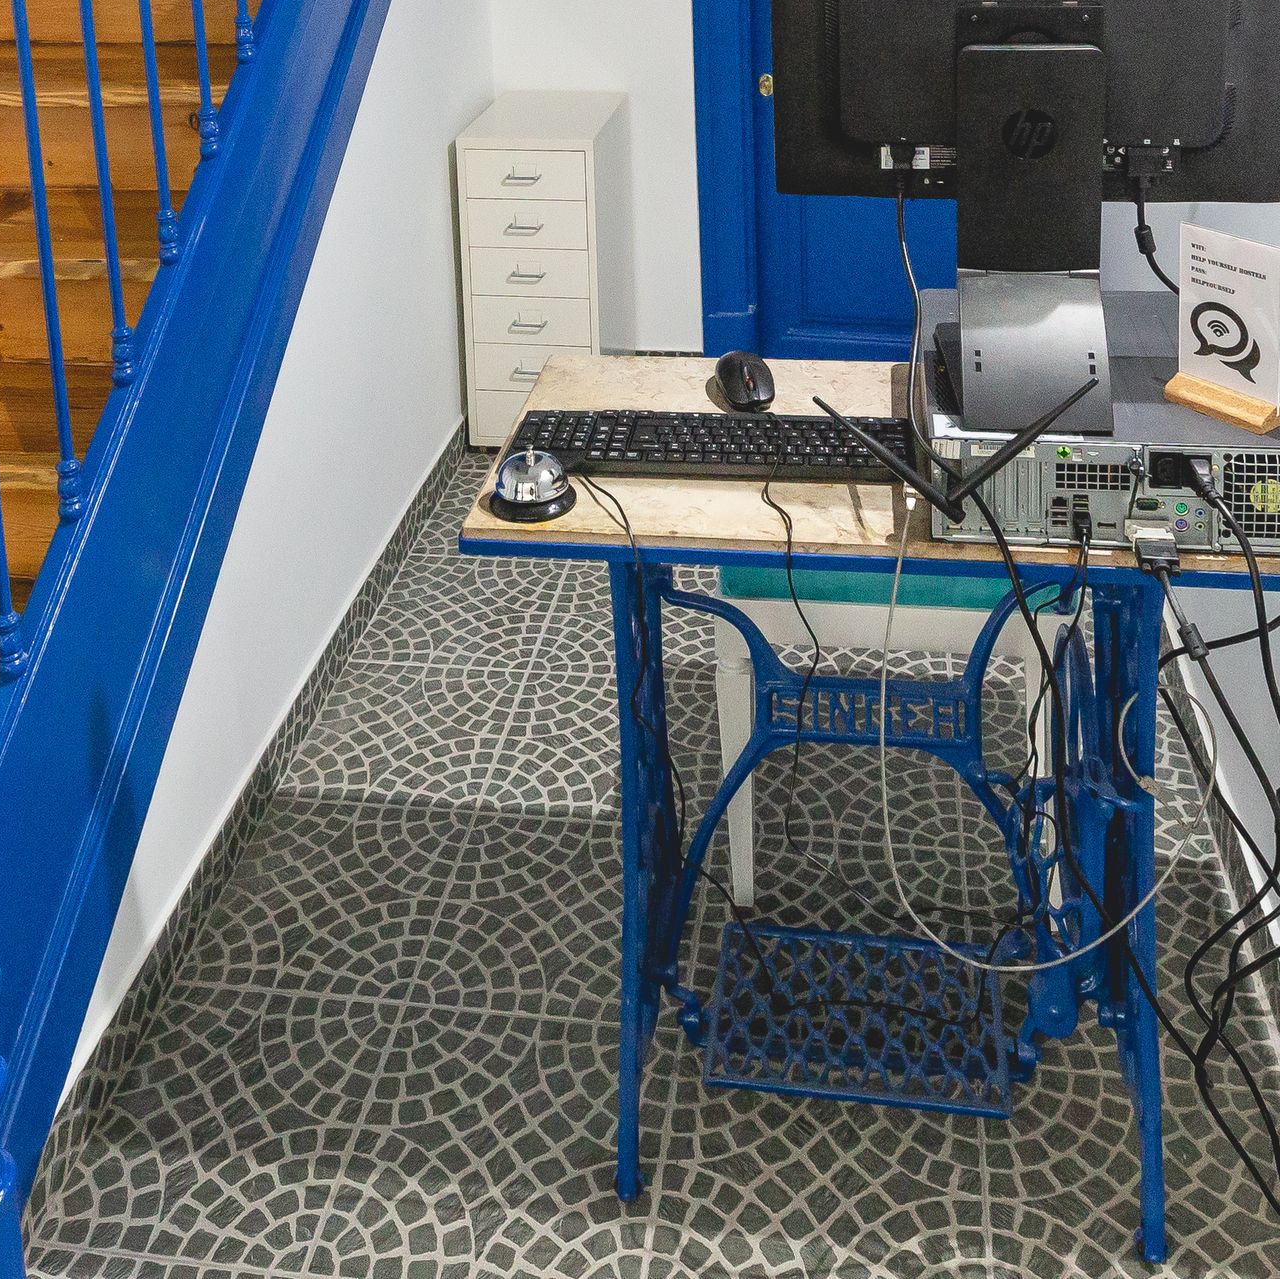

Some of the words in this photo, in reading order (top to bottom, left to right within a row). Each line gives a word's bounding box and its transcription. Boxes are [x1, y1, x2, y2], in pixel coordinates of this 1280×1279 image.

[1011, 108, 1053, 160] hp
[1191, 254, 1207, 263] HELP
[1208, 259, 1237, 272] YOURSELF
[1239, 268, 1266, 280] HOSTELS
[1191, 277, 1235, 294] HELPYOURSELF
